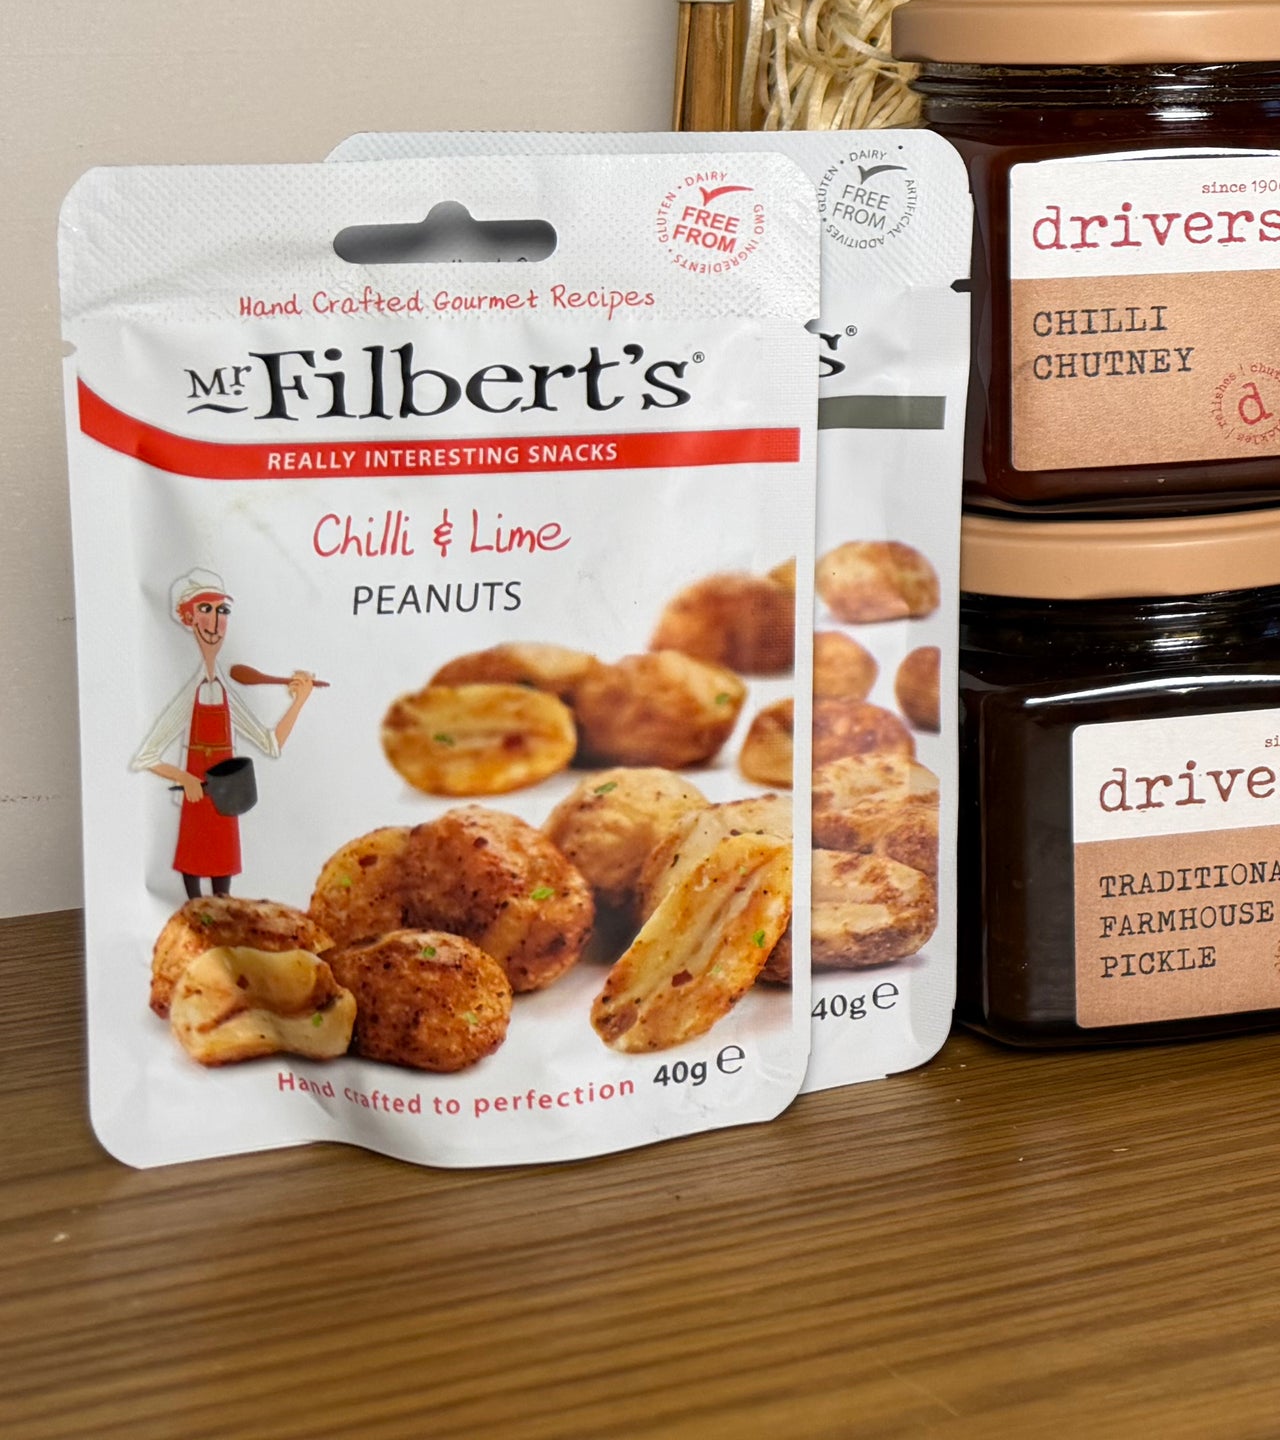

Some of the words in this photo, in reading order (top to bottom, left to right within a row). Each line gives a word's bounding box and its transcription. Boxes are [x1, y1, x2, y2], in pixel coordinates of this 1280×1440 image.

[849, 149, 887, 162] DAIRY
[684, 171, 728, 186] DAIRY
[818, 166, 838, 213] GLUTEN
[1201, 180, 1247, 194] since
[842, 185, 890, 211] FREE
[888, 179, 917, 239] ARTIFICIAL
[657, 192, 677, 243] GLUTEN
[681, 206, 740, 233] FREE
[753, 204, 764, 235] GMO
[832, 202, 886, 230] FROM
[673, 224, 737, 253] FROM
[826, 224, 885, 249] ADDITIVES
[673, 240, 760, 274] INGREDIENTS
[238, 293, 303, 317] Hand
[312, 289, 423, 315] Crafted
[433, 289, 539, 314] Gourmet
[550, 284, 657, 320] Recipes
[1033, 306, 1168, 338] CHILLI
[1033, 347, 1195, 380] CHUTNEY
[1238, 382, 1274, 425] d
[267, 448, 355, 471] REALLY
[364, 444, 520, 469] INTERESTING
[527, 441, 619, 464] SNACKS
[312, 514, 415, 558] Chilli
[434, 508, 455, 555] &
[469, 510, 573, 554] Lime
[351, 579, 522, 617] PEANUTS
[1099, 901, 1275, 939] FARMHOUSE
[1099, 946, 1217, 979] PICKLE
[812, 990, 867, 1022] 40g
[653, 1056, 708, 1089] 40g
[278, 1072, 334, 1098] Hand
[344, 1087, 421, 1114] crafted
[433, 1097, 460, 1114] to
[474, 1079, 634, 1118] perfection
